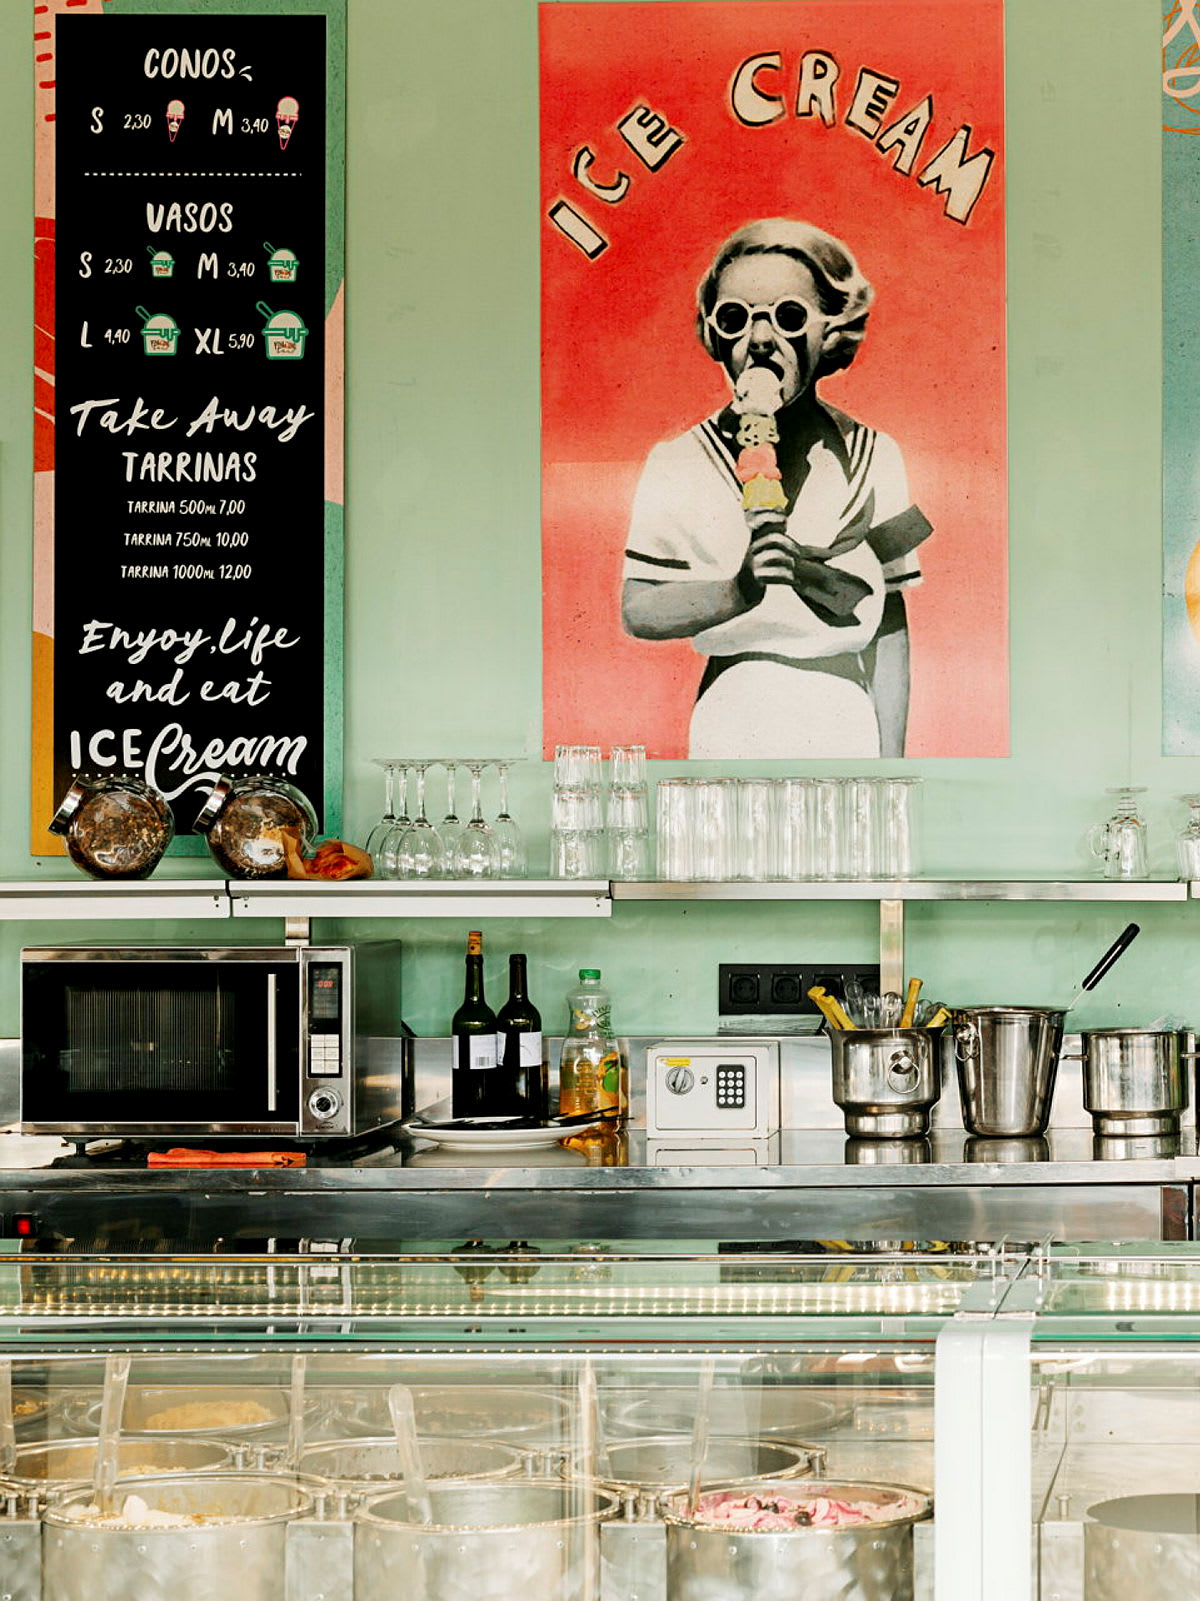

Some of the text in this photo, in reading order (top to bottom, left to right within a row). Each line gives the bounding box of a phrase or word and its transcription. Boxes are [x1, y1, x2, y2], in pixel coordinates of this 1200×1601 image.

[143, 48, 236, 79] CONOS
[90, 106, 152, 134] S 2,30
[212, 108, 269, 136] M 3,40
[548, 50, 995, 260] ICE CREAM
[146, 202, 234, 233] VASOS
[78, 250, 133, 279] S 2,30
[197, 252, 219, 280] M
[227, 262, 256, 279] 3,40
[80, 320, 93, 349] L
[104, 328, 131, 345] 4,40
[194, 327, 225, 355] XL
[228, 333, 255, 350] 5,90
[69, 395, 315, 443] Take Away
[121, 451, 258, 483] TARRINAS
[127, 500, 176, 515] TARRINA
[219, 499, 246, 516] 7,00
[123, 532, 172, 547] TARRINA
[215, 531, 249, 549] 10,00
[120, 565, 169, 579] TARRINA
[218, 564, 252, 581] 12,00
[105, 668, 272, 706] and eat
[70, 722, 308, 800] ICE Cream
